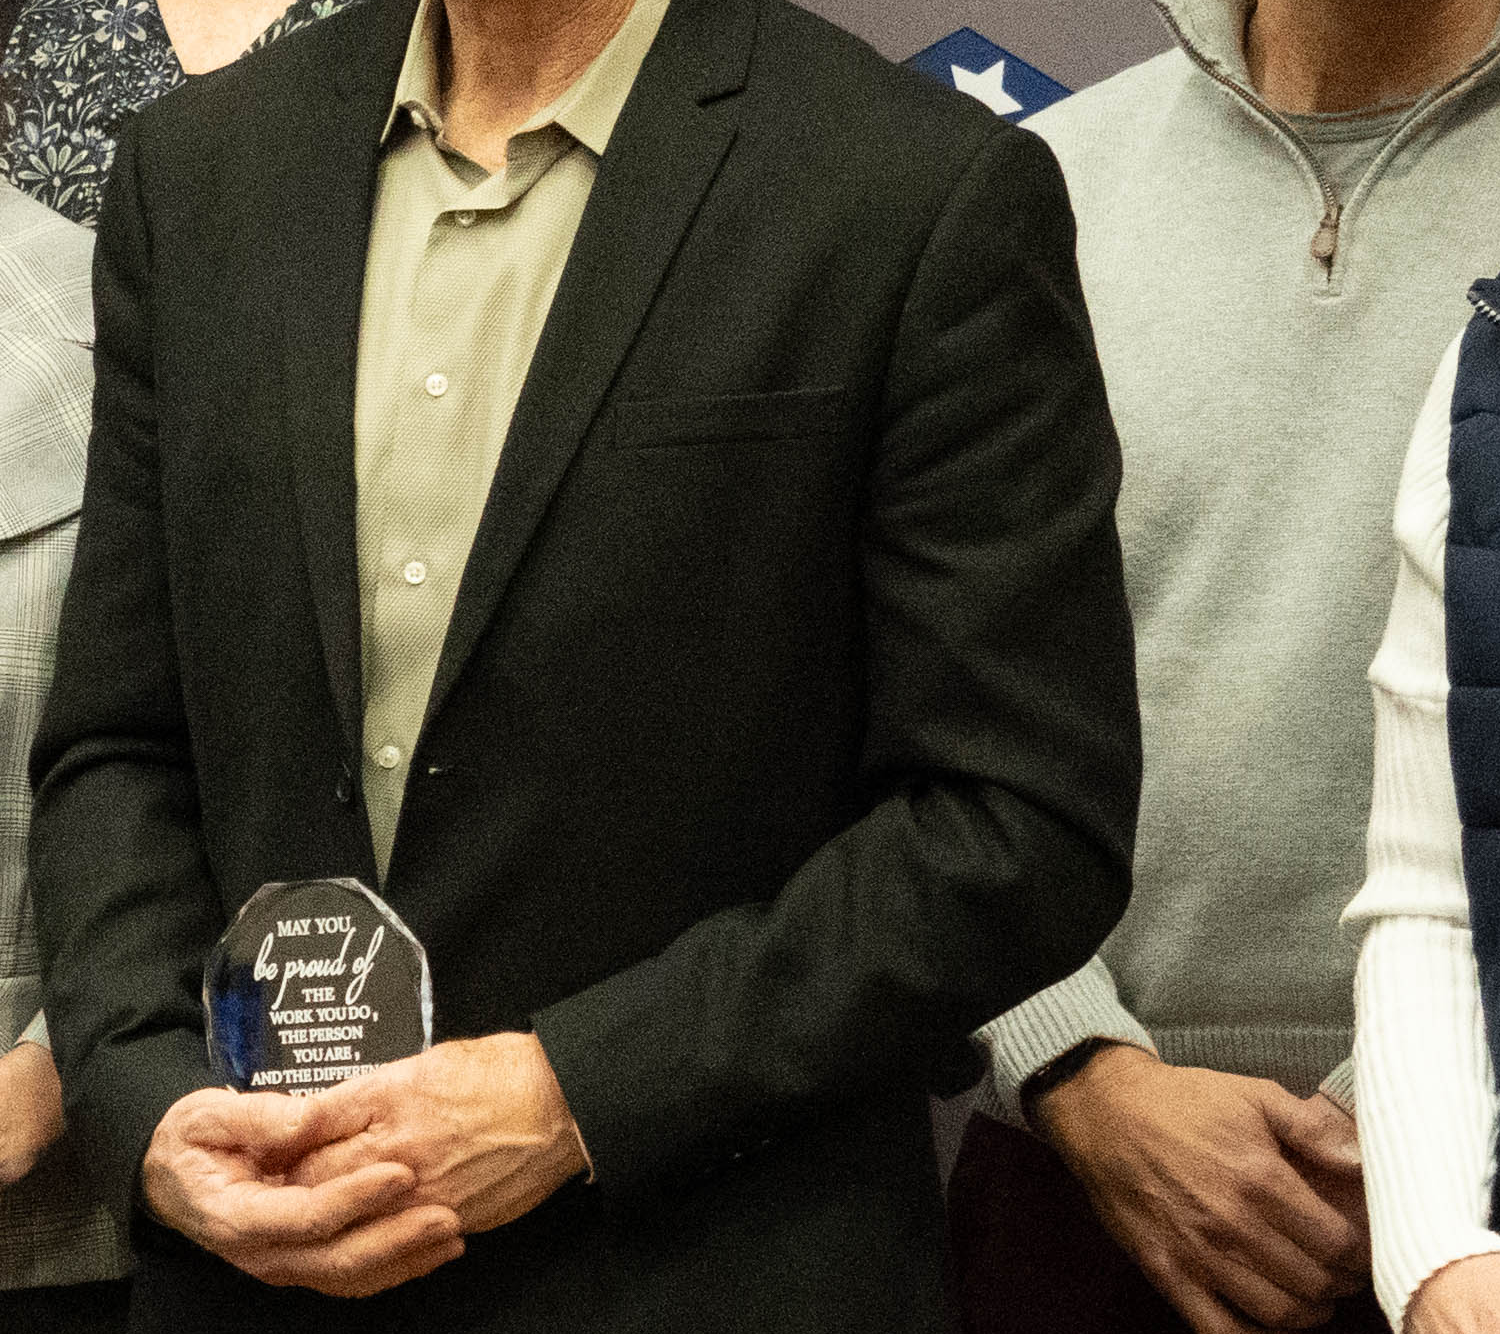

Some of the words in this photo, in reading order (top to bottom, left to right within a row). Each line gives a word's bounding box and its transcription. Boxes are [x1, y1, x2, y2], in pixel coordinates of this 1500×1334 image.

[277, 919, 313, 937] MAY
[315, 916, 351, 934] YOU
[254, 933, 278, 981] be
[271, 927, 356, 1010] proud
[345, 926, 385, 1005] of
[301, 987, 336, 1003] THE
[269, 1010, 314, 1025] WORK
[315, 1007, 348, 1022] YOU
[278, 1030, 309, 1044] THE
[309, 1026, 364, 1043] PERSON
[293, 1049, 324, 1063] YOU
[251, 1071, 282, 1086] AND
[283, 1068, 312, 1084] THE
[313, 1064, 382, 1082] DIFFEREN
